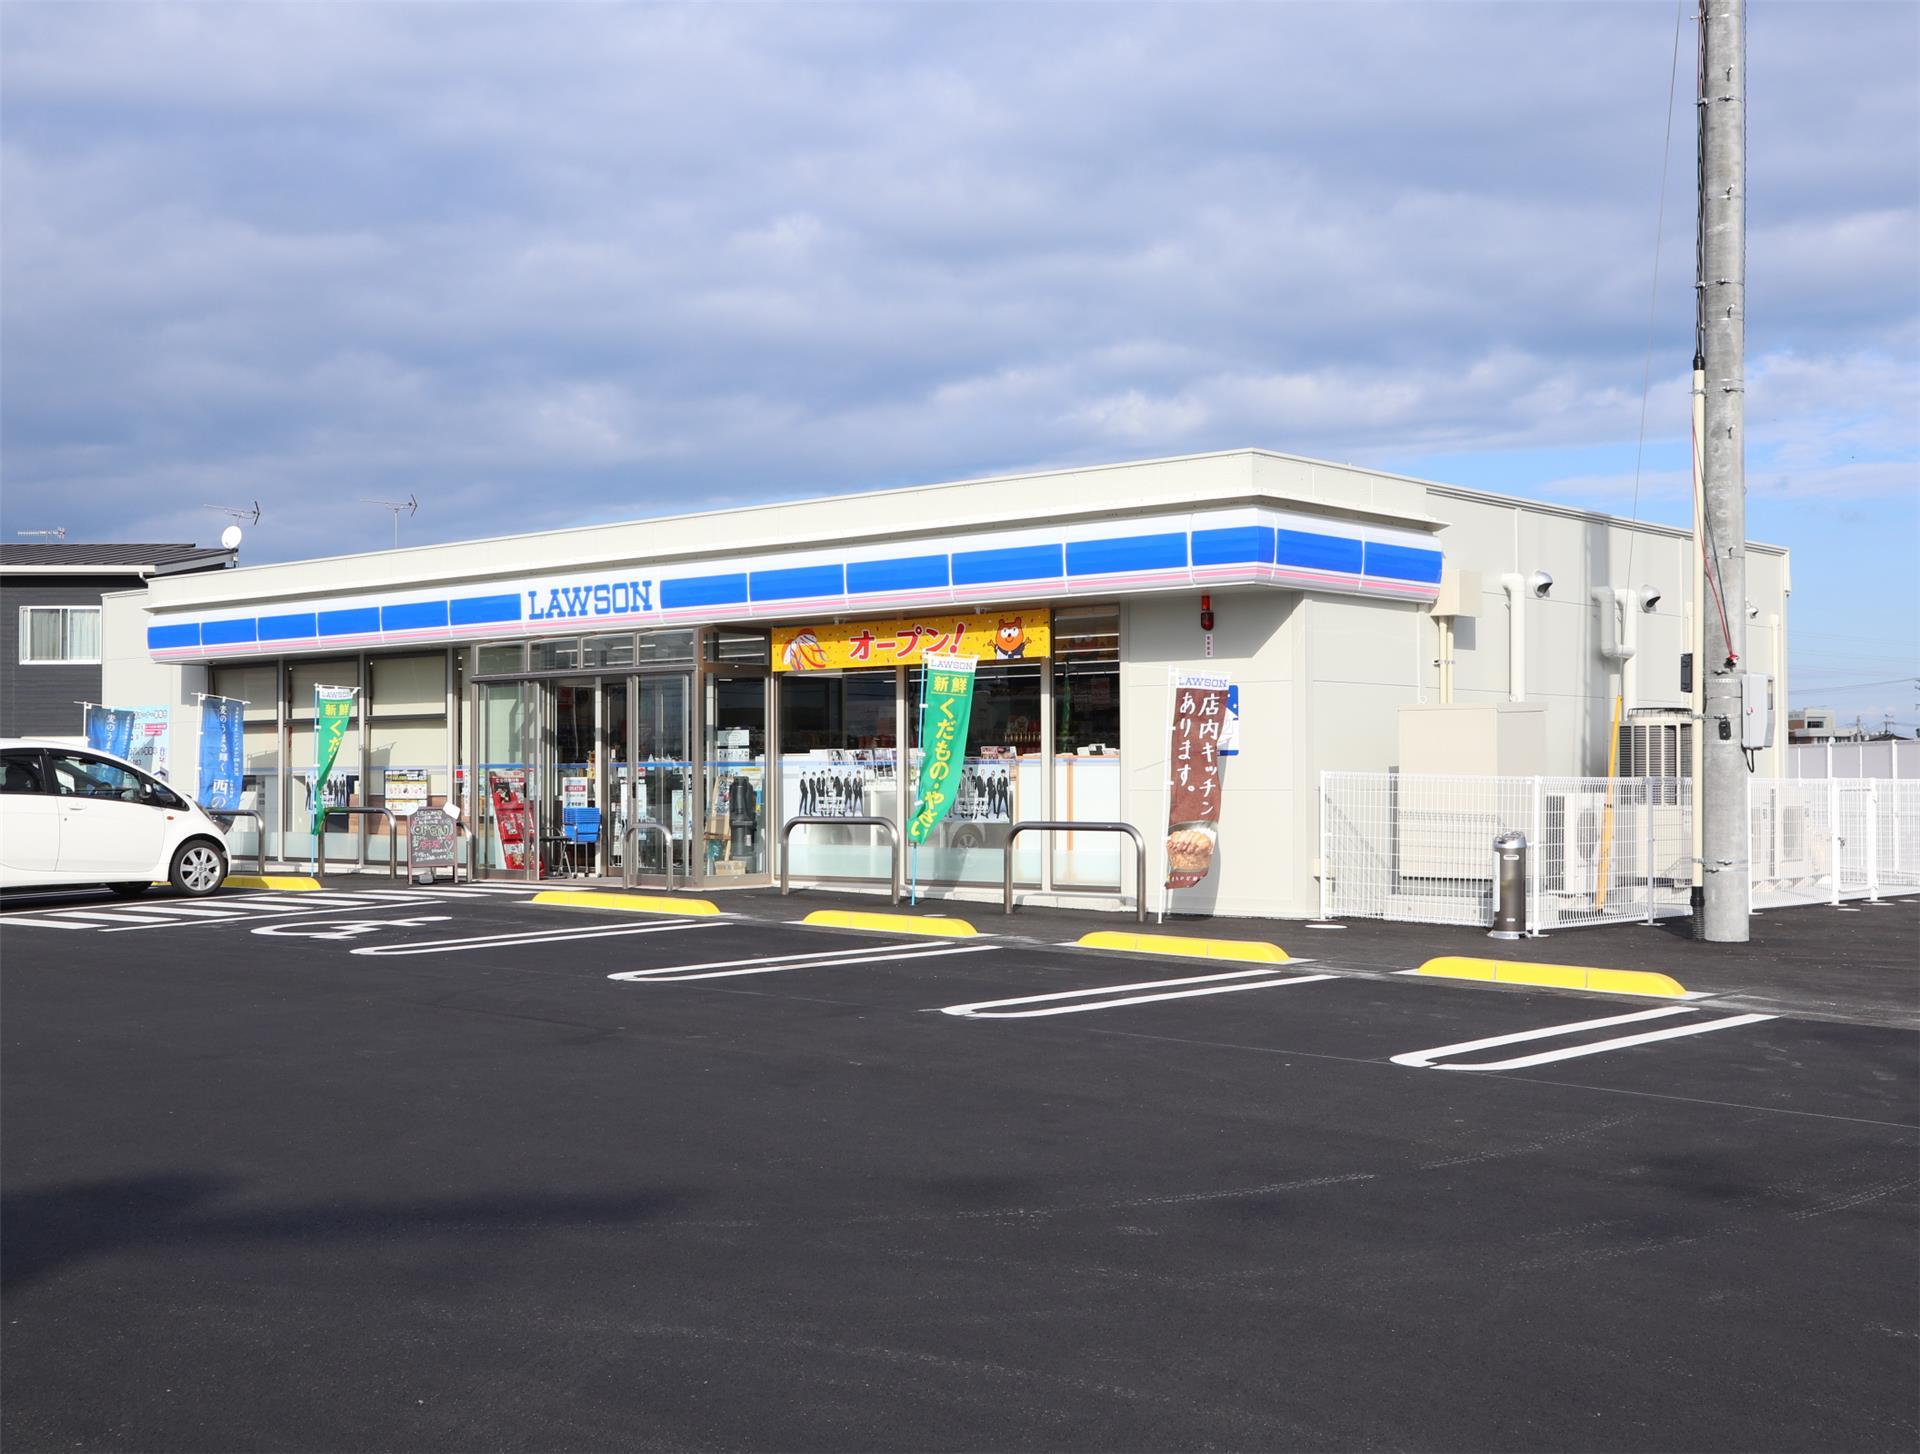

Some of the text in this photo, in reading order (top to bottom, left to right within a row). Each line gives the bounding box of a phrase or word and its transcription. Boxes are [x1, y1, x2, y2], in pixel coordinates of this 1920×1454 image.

[528, 580, 652, 620] LAWSON
[930, 658, 973, 670] LAWSON
[933, 675, 967, 694] 新鮮
[1178, 676, 1227, 688] LAWSON
[325, 703, 350, 717] 新鮮
[1177, 691, 1196, 792] あります。
[1198, 692, 1221, 816] 店内キッチン
